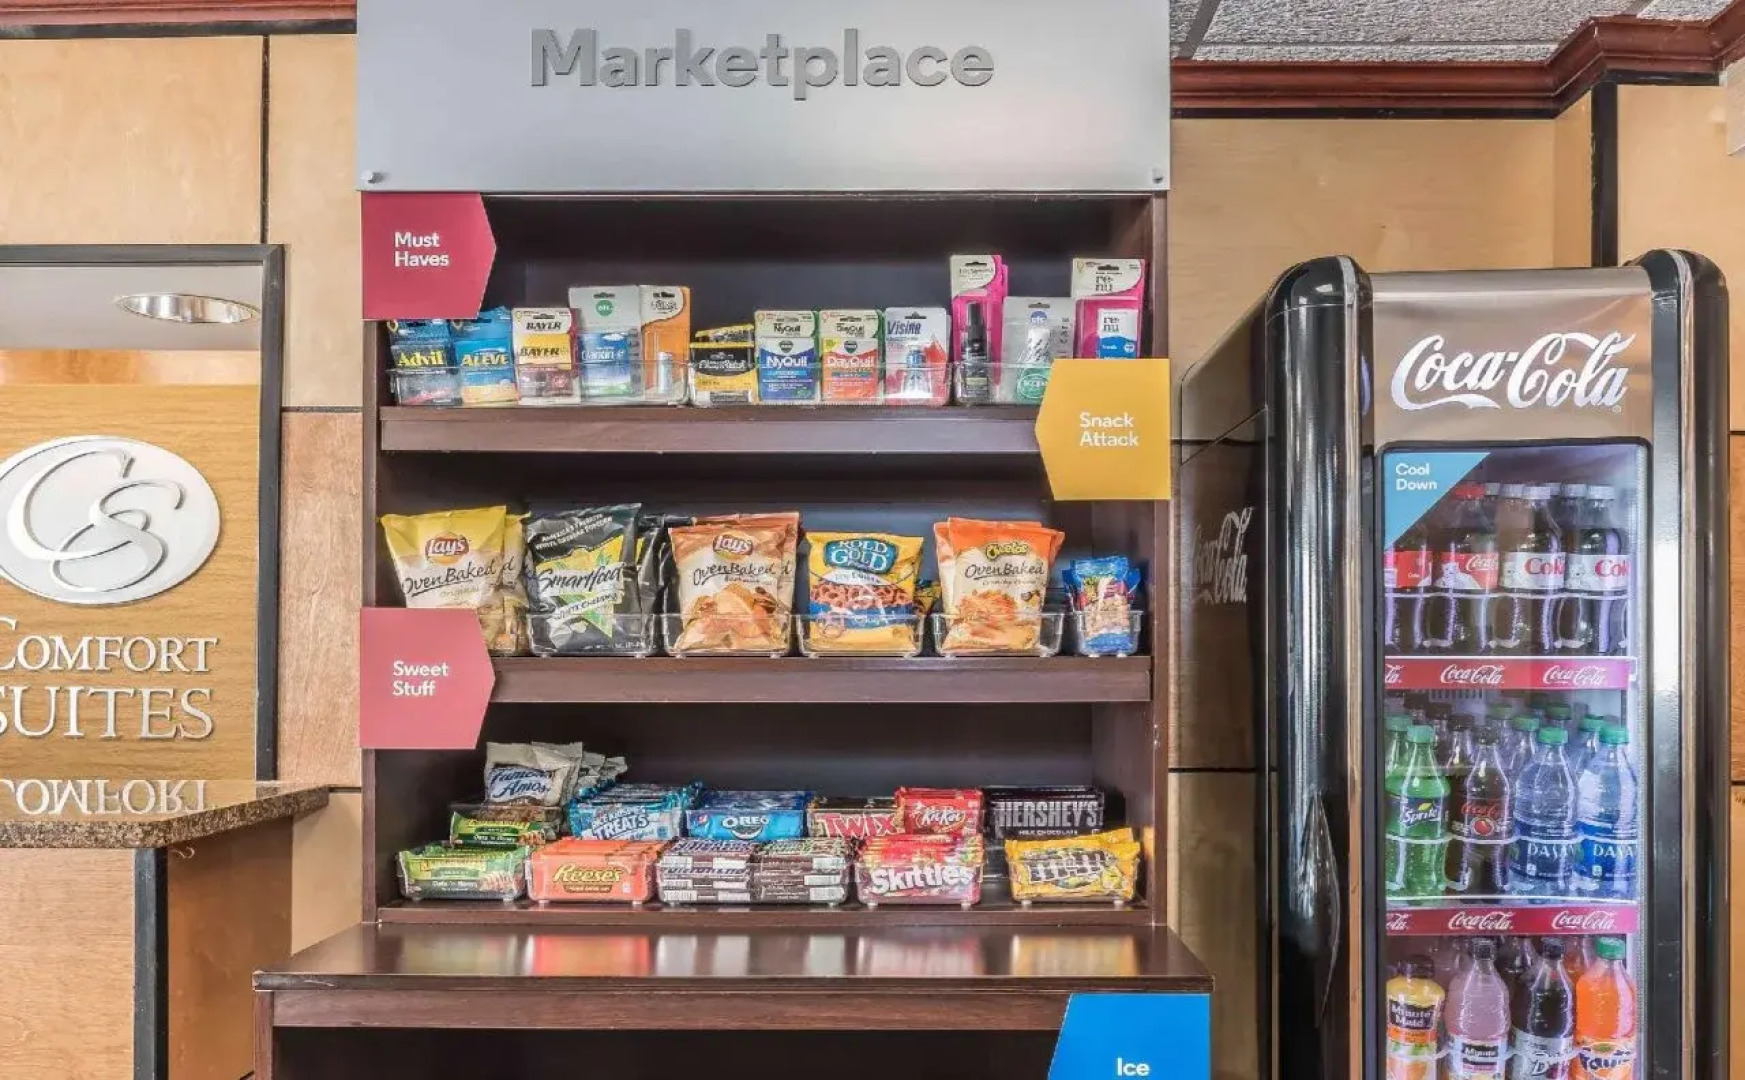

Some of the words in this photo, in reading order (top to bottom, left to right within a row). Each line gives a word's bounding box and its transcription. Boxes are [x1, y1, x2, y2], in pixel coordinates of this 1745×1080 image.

[530, 28, 995, 101] Marketplace
[394, 231, 441, 248] Must
[394, 250, 450, 267] Haves
[525, 321, 563, 331] BAYER
[887, 320, 923, 335] Visine
[397, 350, 444, 367] Advil
[461, 354, 509, 367] ALEVE
[519, 347, 561, 358] BAYER
[765, 355, 809, 369] NyQuil
[827, 355, 875, 370] DayQuil
[1391, 331, 1637, 412] Coca-Cola
[1079, 411, 1135, 428] Snack
[1079, 430, 1140, 447] Attack
[1395, 463, 1431, 477] Cool
[1395, 479, 1438, 491] Down
[423, 535, 468, 557] Lay's
[839, 540, 888, 554] ROLD
[830, 549, 888, 572] GOLD
[401, 573, 442, 595] Oven
[442, 561, 498, 583] Baked
[693, 563, 728, 586] Oven
[729, 561, 776, 578] Baked
[964, 563, 1001, 579] Oven
[1003, 561, 1045, 576] Baked
[392, 659, 450, 677] Sweet
[1440, 663, 1504, 686] Coca-Cola
[1543, 664, 1608, 686] Coca-Cola
[392, 680, 436, 696] Stuff
[0, 684, 214, 741] UITES
[721, 815, 770, 828] OREO
[999, 801, 1099, 828] HERSHEY'S
[593, 814, 648, 842] TREATS
[818, 812, 899, 840] TWIX
[553, 861, 624, 883] Reese's
[870, 864, 975, 894] Skittles
[1448, 911, 1516, 931] Coca-Cola
[1552, 911, 1618, 931] Coca-Cola
[1391, 1003, 1432, 1019] Minute
[1395, 1015, 1425, 1029] Maid
[1117, 1057, 1150, 1076] Ice
